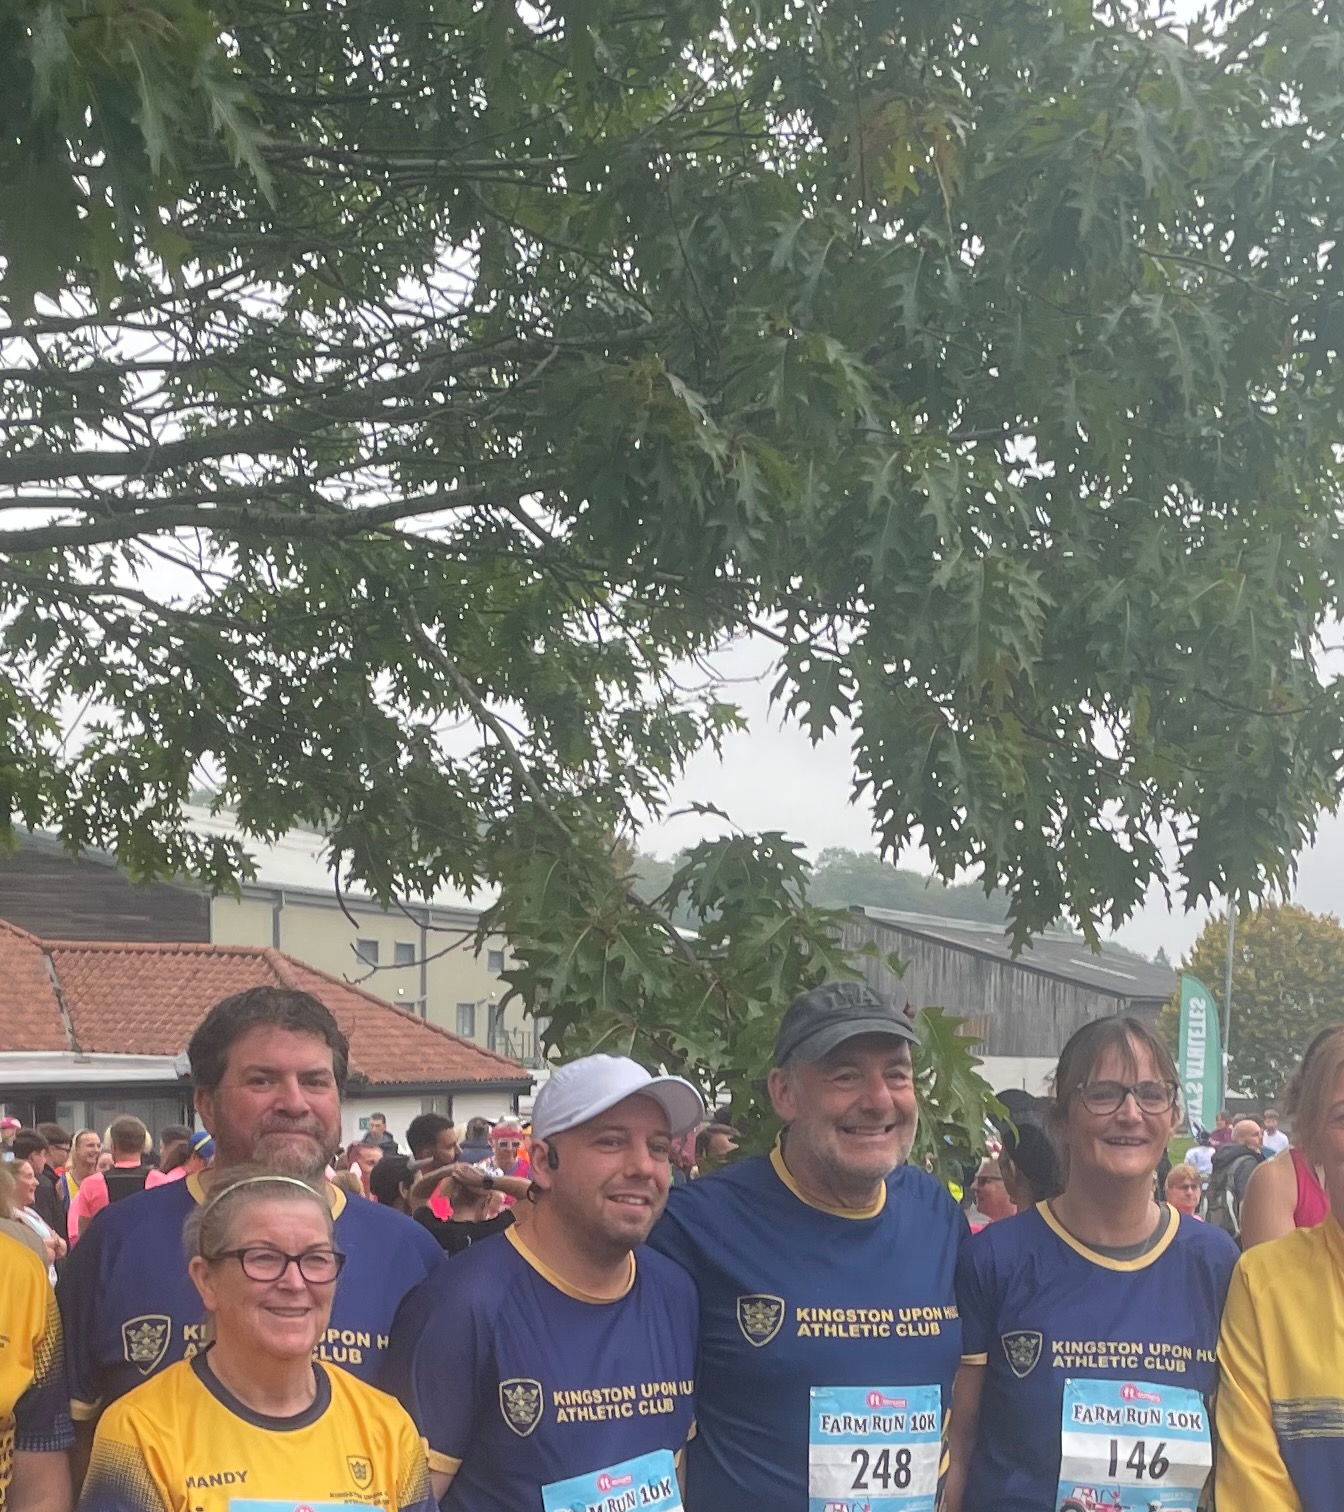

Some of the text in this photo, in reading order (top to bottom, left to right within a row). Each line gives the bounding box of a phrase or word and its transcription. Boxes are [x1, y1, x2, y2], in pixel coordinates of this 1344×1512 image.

[796, 1308, 894, 1322] KINGSTON
[899, 1307, 942, 1321] UPON
[319, 1328, 370, 1348] PON
[797, 1322, 941, 1337] ATHLETIC CLUB
[1052, 1341, 1217, 1362] KINGSTON UPON HU
[1053, 1355, 1186, 1372] ATHLETIC CLUB
[553, 1385, 636, 1406] KINGSTON
[641, 1381, 677, 1398] UPON
[556, 1398, 674, 1423] ATHLETIC CLUB
[1074, 1405, 1201, 1430] FARM RUN 10K
[821, 1414, 936, 1433] FARM RUN 10K
[851, 1448, 912, 1490] 248
[1108, 1439, 1170, 1479] 146
[185, 1470, 248, 1489] MANDY
